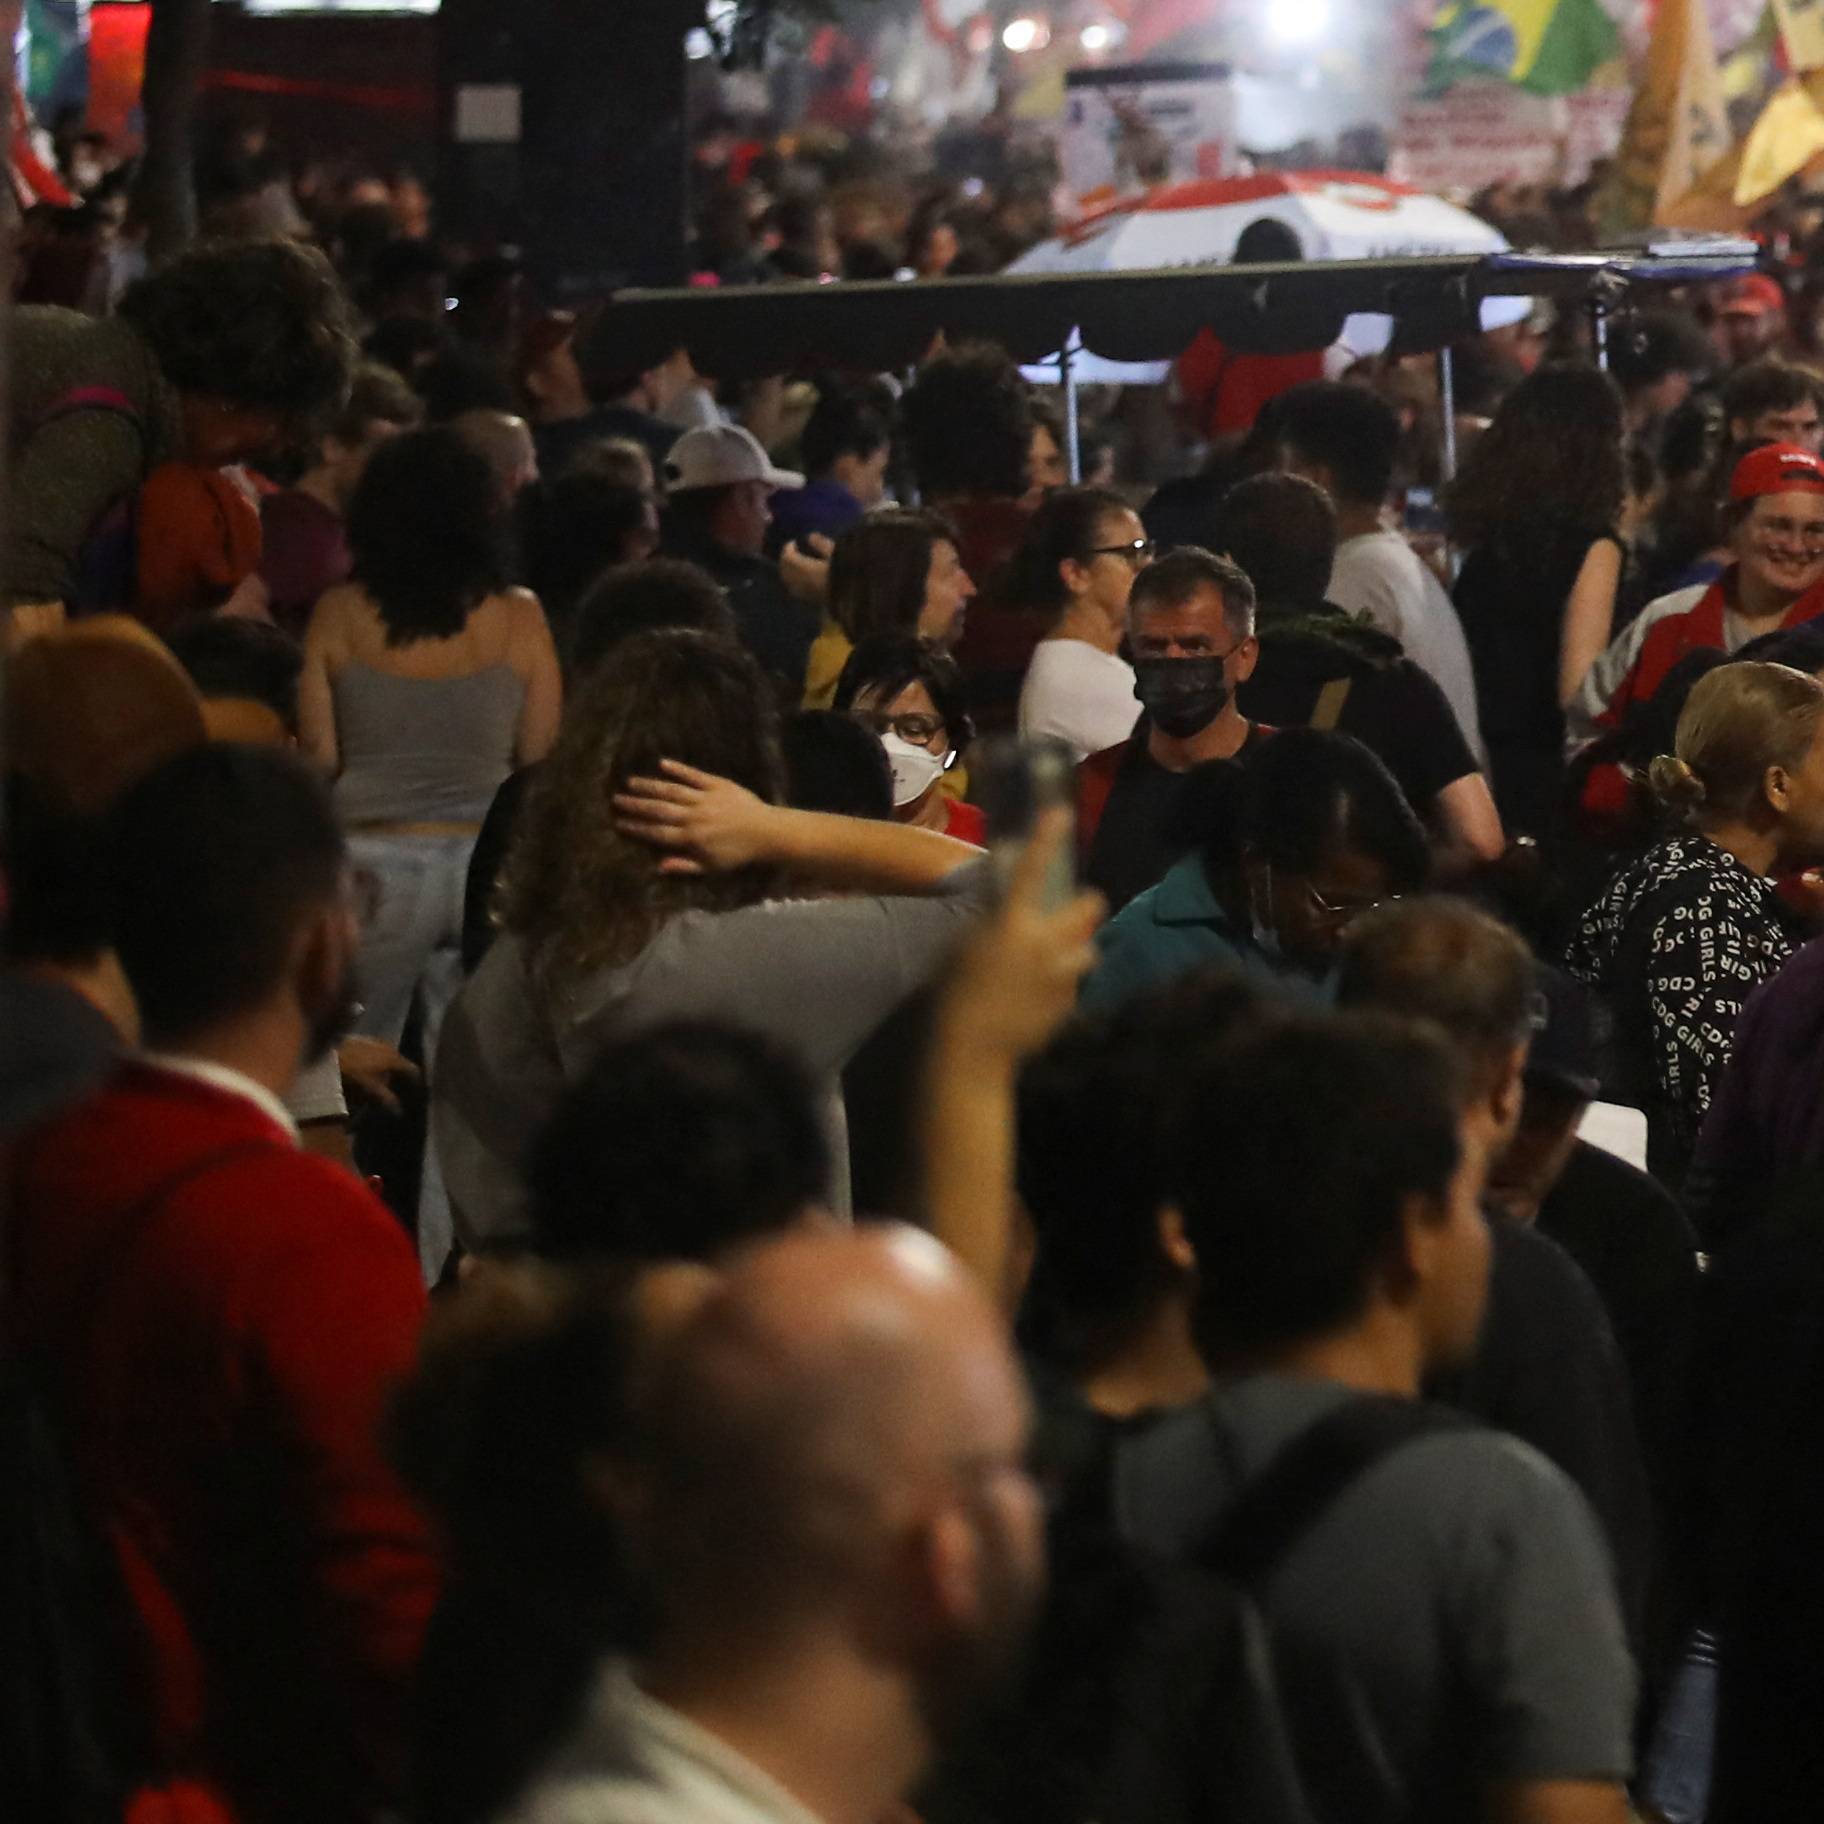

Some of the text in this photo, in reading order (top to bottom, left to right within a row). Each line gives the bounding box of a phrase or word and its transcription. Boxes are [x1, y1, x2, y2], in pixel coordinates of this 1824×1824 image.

[1698, 926, 1717, 982] GIRLS
[1658, 976, 1697, 992] CDG
[1652, 996, 1677, 1029] CDG
[1677, 1026, 1717, 1069] GIRLS
